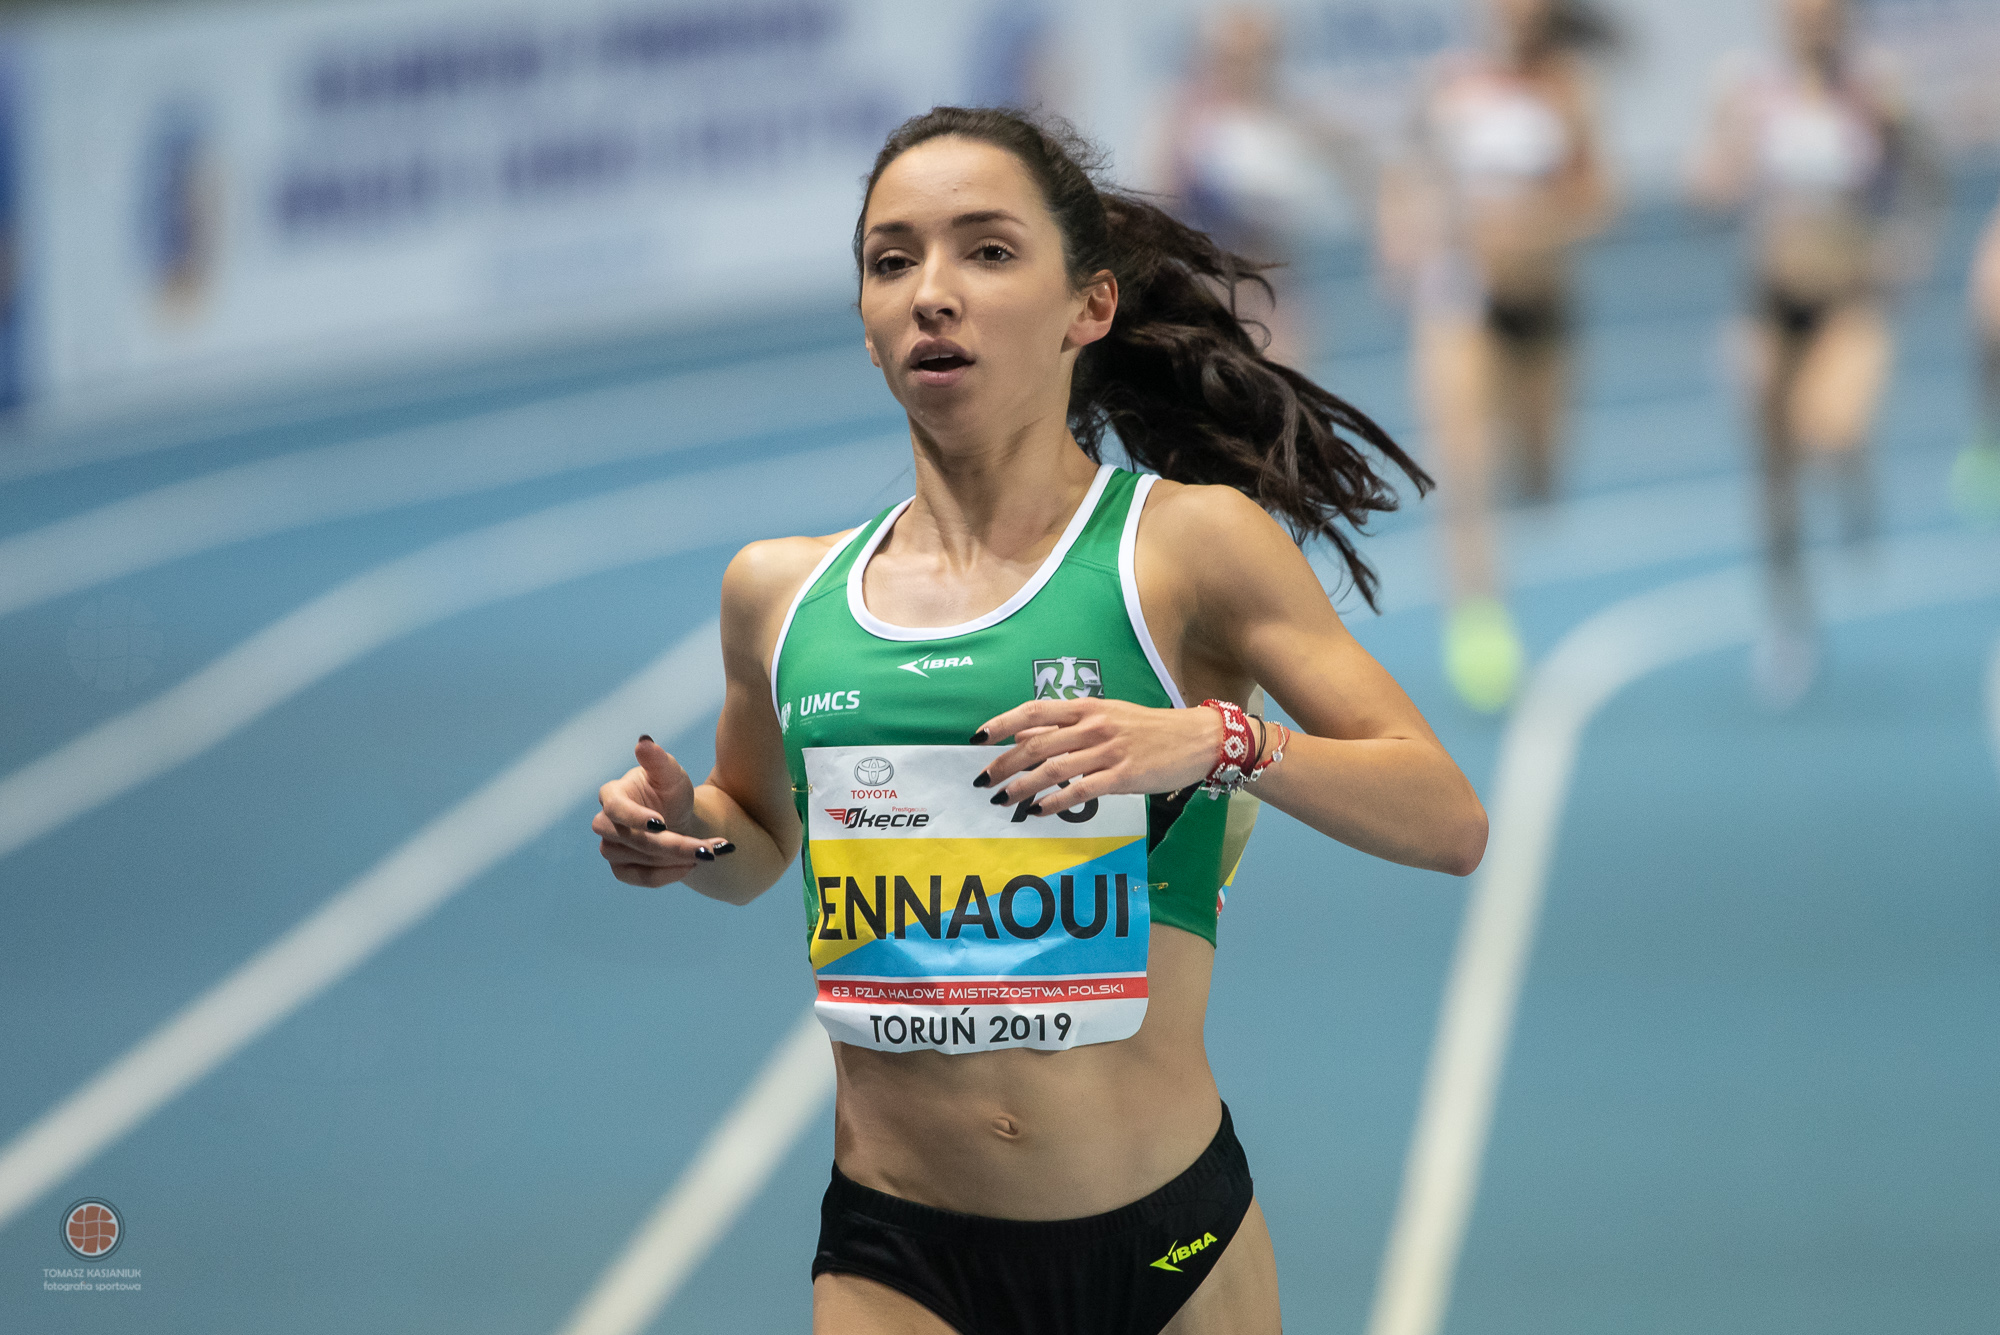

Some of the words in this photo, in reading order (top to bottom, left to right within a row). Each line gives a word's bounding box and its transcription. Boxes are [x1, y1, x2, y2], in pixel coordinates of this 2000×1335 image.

[799, 690, 861, 717] UMCS
[850, 789, 898, 799] TOYOTA
[817, 873, 1129, 940] ENNAOUI
[831, 987, 853, 998] 63.
[855, 987, 888, 999] PZLA
[888, 988, 945, 999] HALOWE
[948, 986, 1063, 999] MISTRZOSTWA
[1067, 983, 1125, 997] POLSKI
[869, 1007, 976, 1045] TORUŃ
[989, 1012, 1072, 1043] 2019
